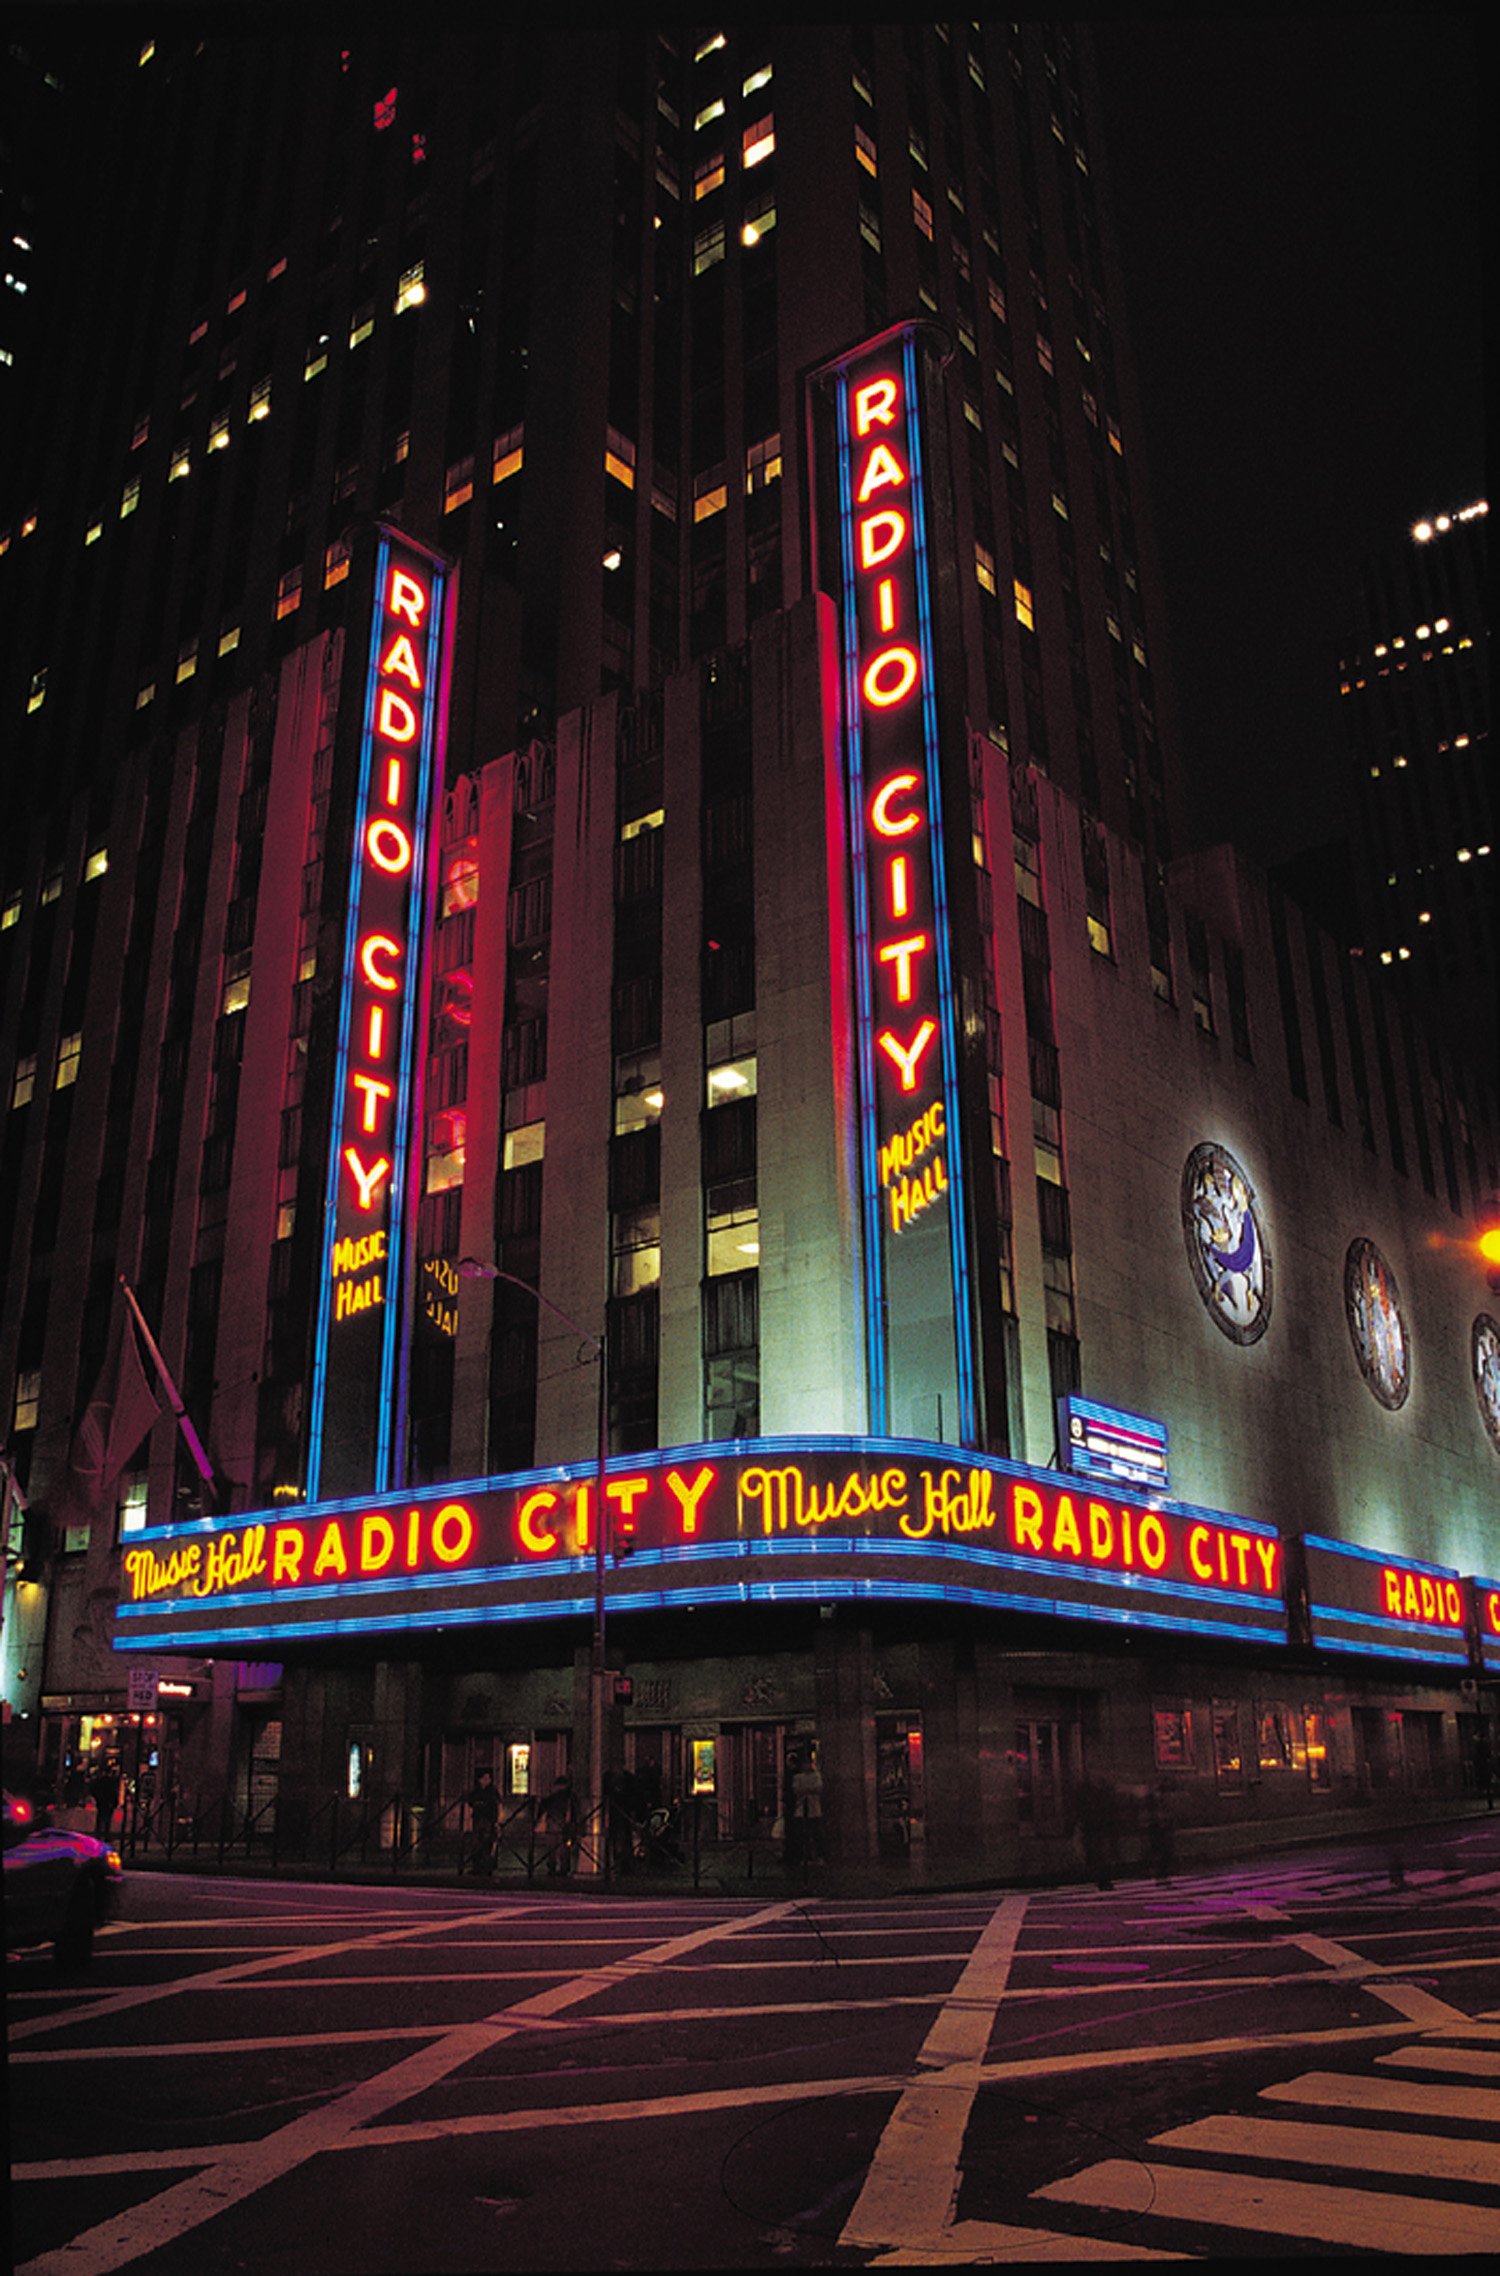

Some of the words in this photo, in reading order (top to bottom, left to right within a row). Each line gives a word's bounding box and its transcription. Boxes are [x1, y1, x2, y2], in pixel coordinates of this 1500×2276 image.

[854, 377, 918, 708] RADIO
[366, 568, 426, 874] RADIO
[870, 773, 936, 1092] CITY
[343, 934, 400, 1211] CITY
[272, 1503, 473, 1583] RADIO
[517, 1466, 715, 1553] CITY
[736, 1465, 908, 1536] Music
[899, 1467, 997, 1539] Hall
[1012, 1484, 1167, 1571] RADIO
[1188, 1525, 1277, 1590] CITY
[125, 1544, 202, 1600] Music
[190, 1524, 267, 1597] Hall
[1383, 1569, 1461, 1623] RADIO
